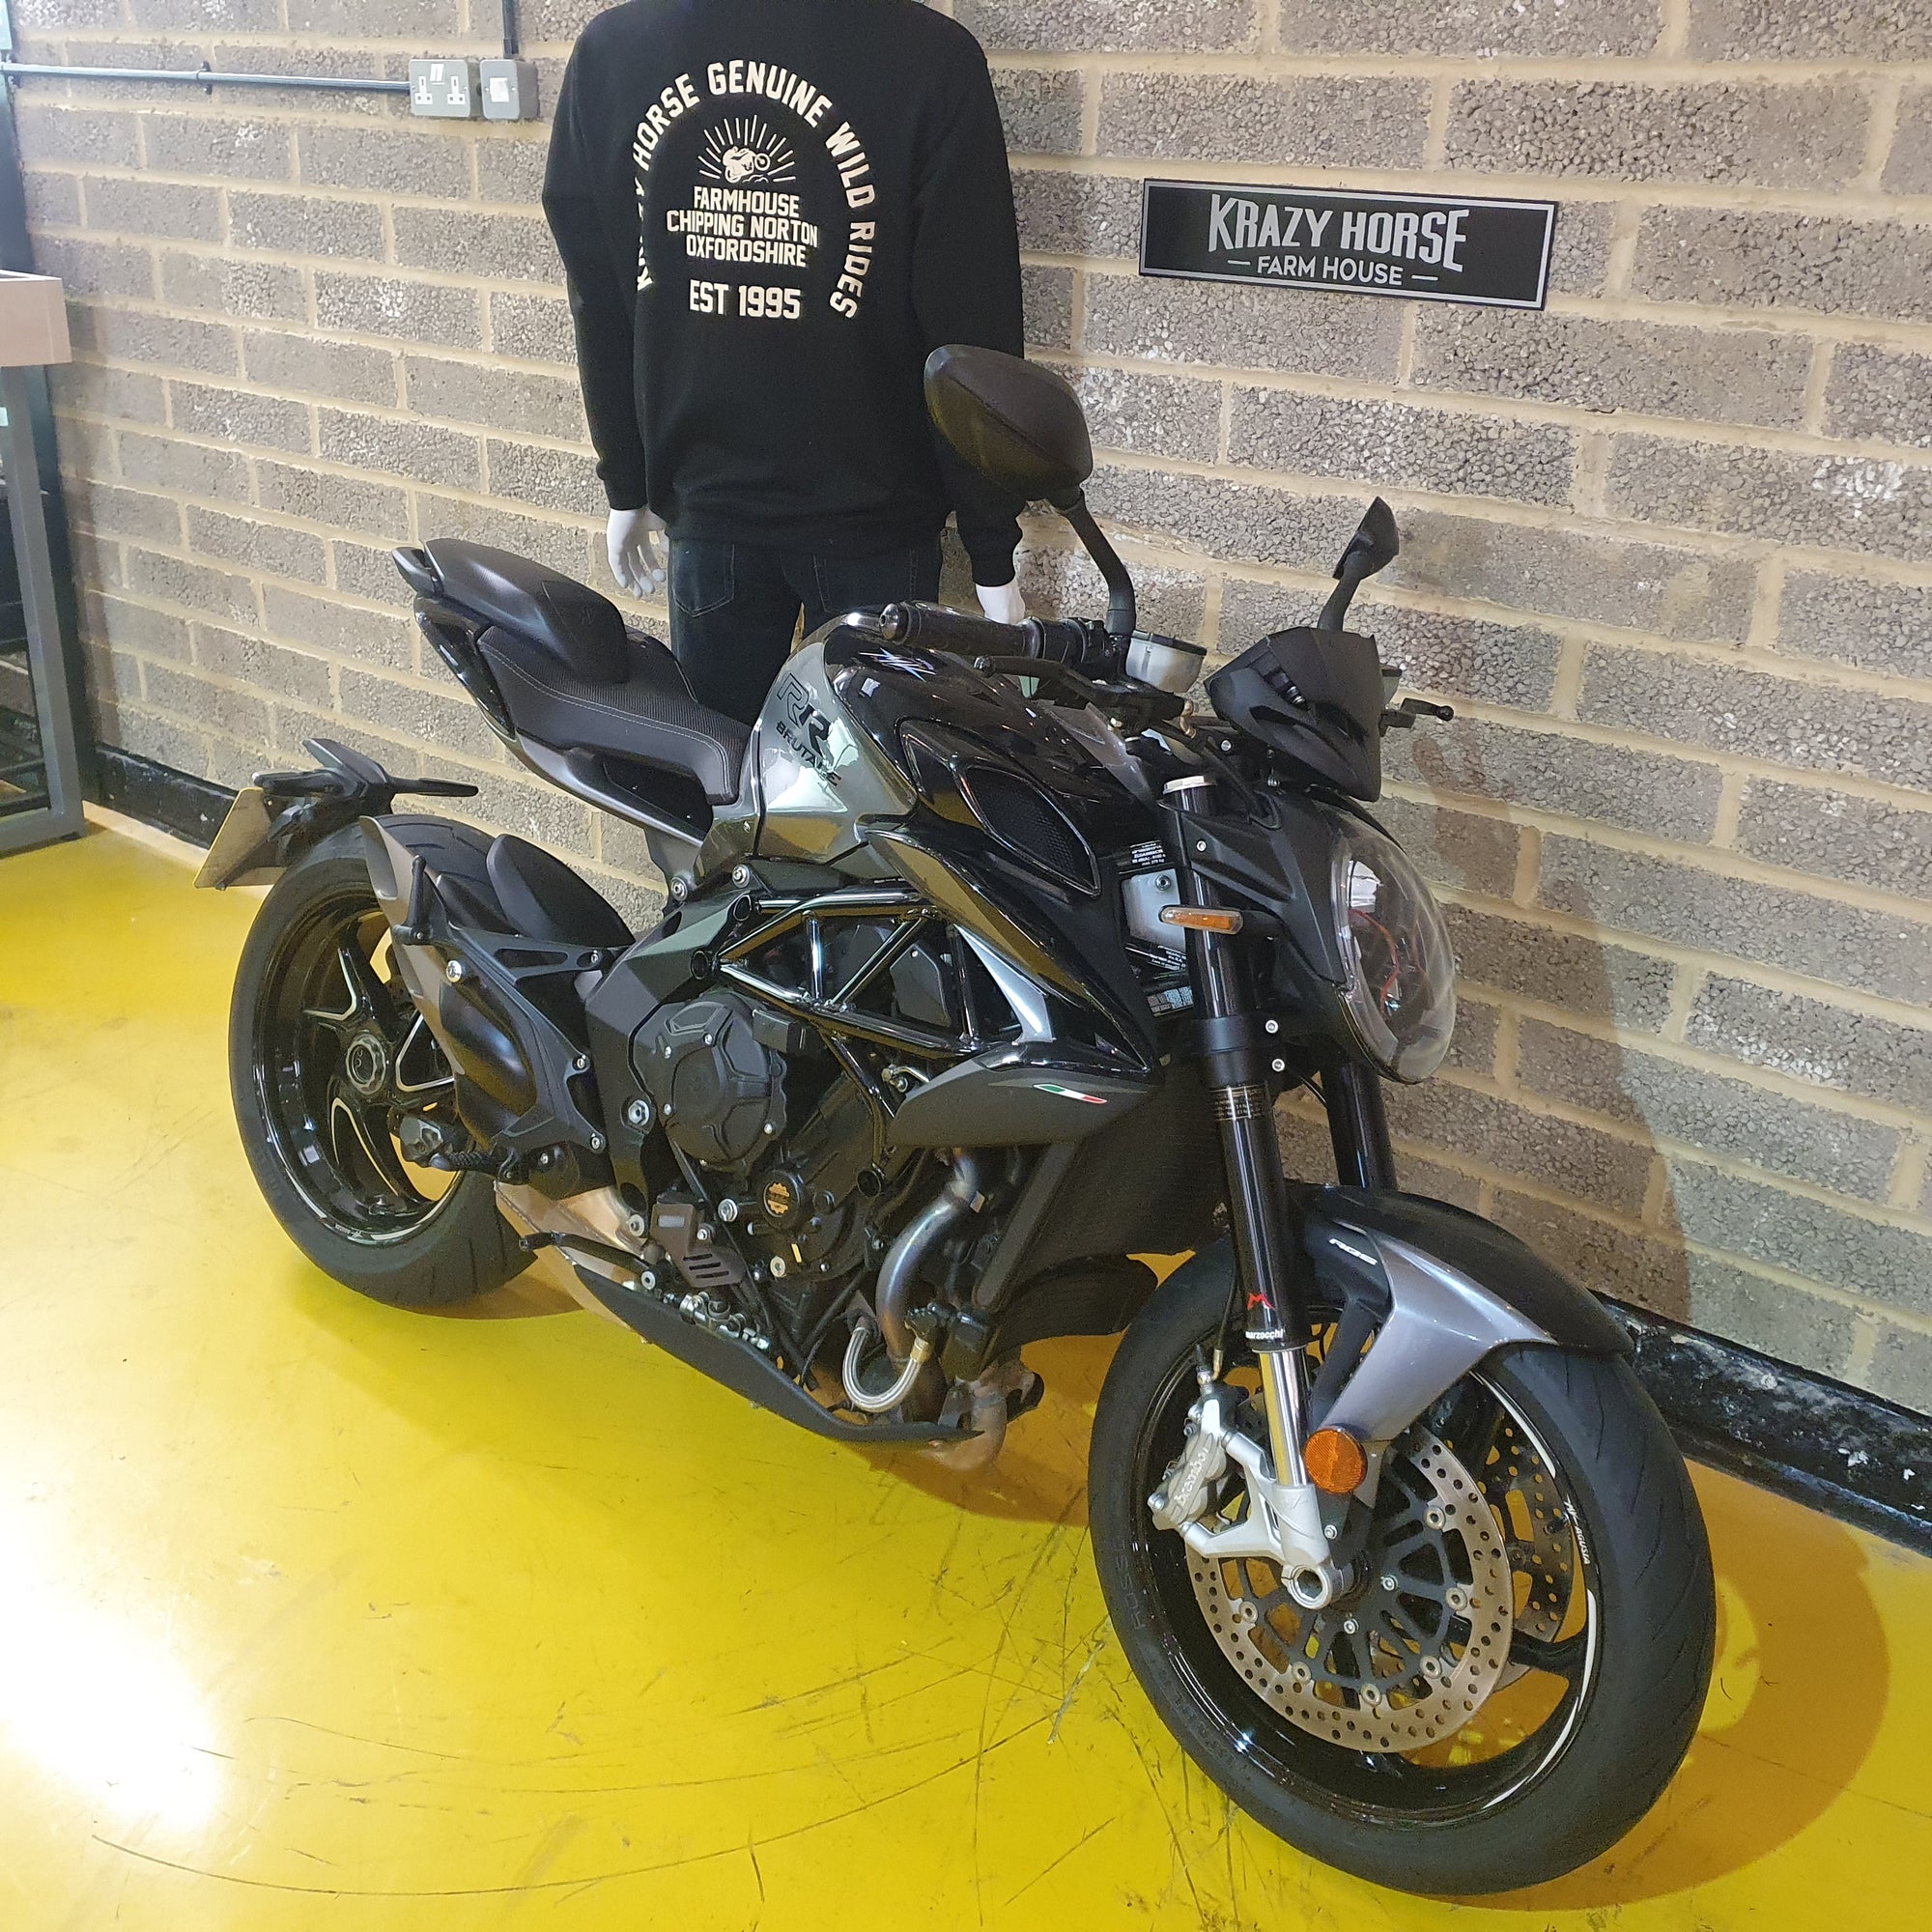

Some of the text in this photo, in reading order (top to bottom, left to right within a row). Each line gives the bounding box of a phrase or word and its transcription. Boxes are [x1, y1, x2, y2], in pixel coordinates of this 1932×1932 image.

[633, 60, 876, 319] HORSE GENUINE WILD RIDES
[694, 185, 800, 217] FARMHOUSE
[667, 210, 818, 247] CHIPPING NORTON
[1208, 193, 1469, 272] KRAZY HORSE
[686, 234, 807, 268] OXFORDSHIRE
[1256, 255, 1403, 286] FARM HOUSE
[690, 279, 801, 319] EST 1995
[776, 721, 842, 787] BRUTAE
